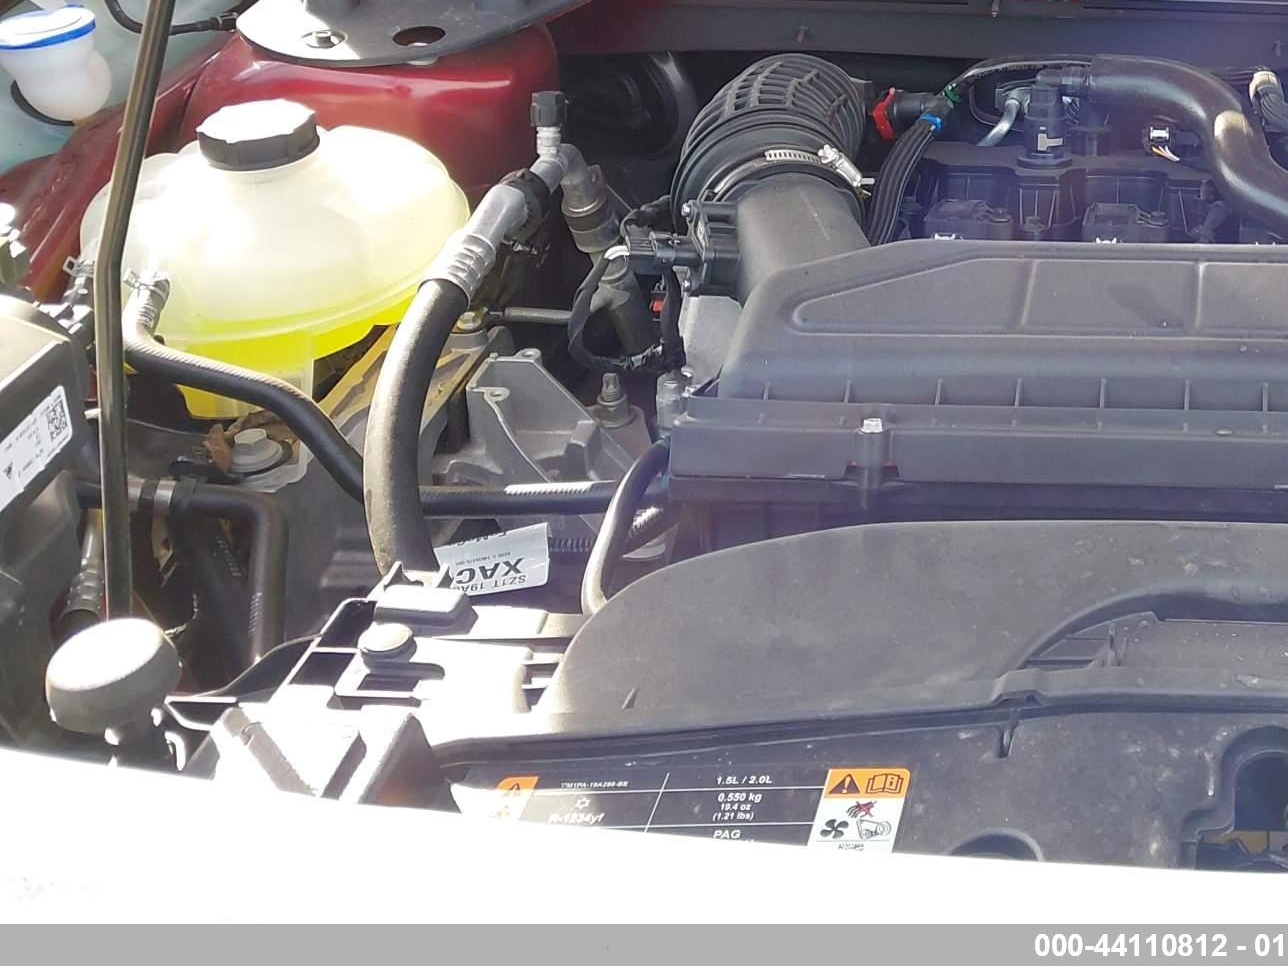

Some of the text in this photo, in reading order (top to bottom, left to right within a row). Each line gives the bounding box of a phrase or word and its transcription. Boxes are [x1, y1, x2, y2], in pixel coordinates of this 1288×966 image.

[456, 557, 524, 585] XAC
[716, 775, 773, 785] 1.5L / 2.0L
[717, 792, 762, 803] 0.550 kg
[720, 803, 738, 811] 19.4
[712, 811, 754, 822] (1.21 lbs)
[713, 829, 741, 840] PAG
